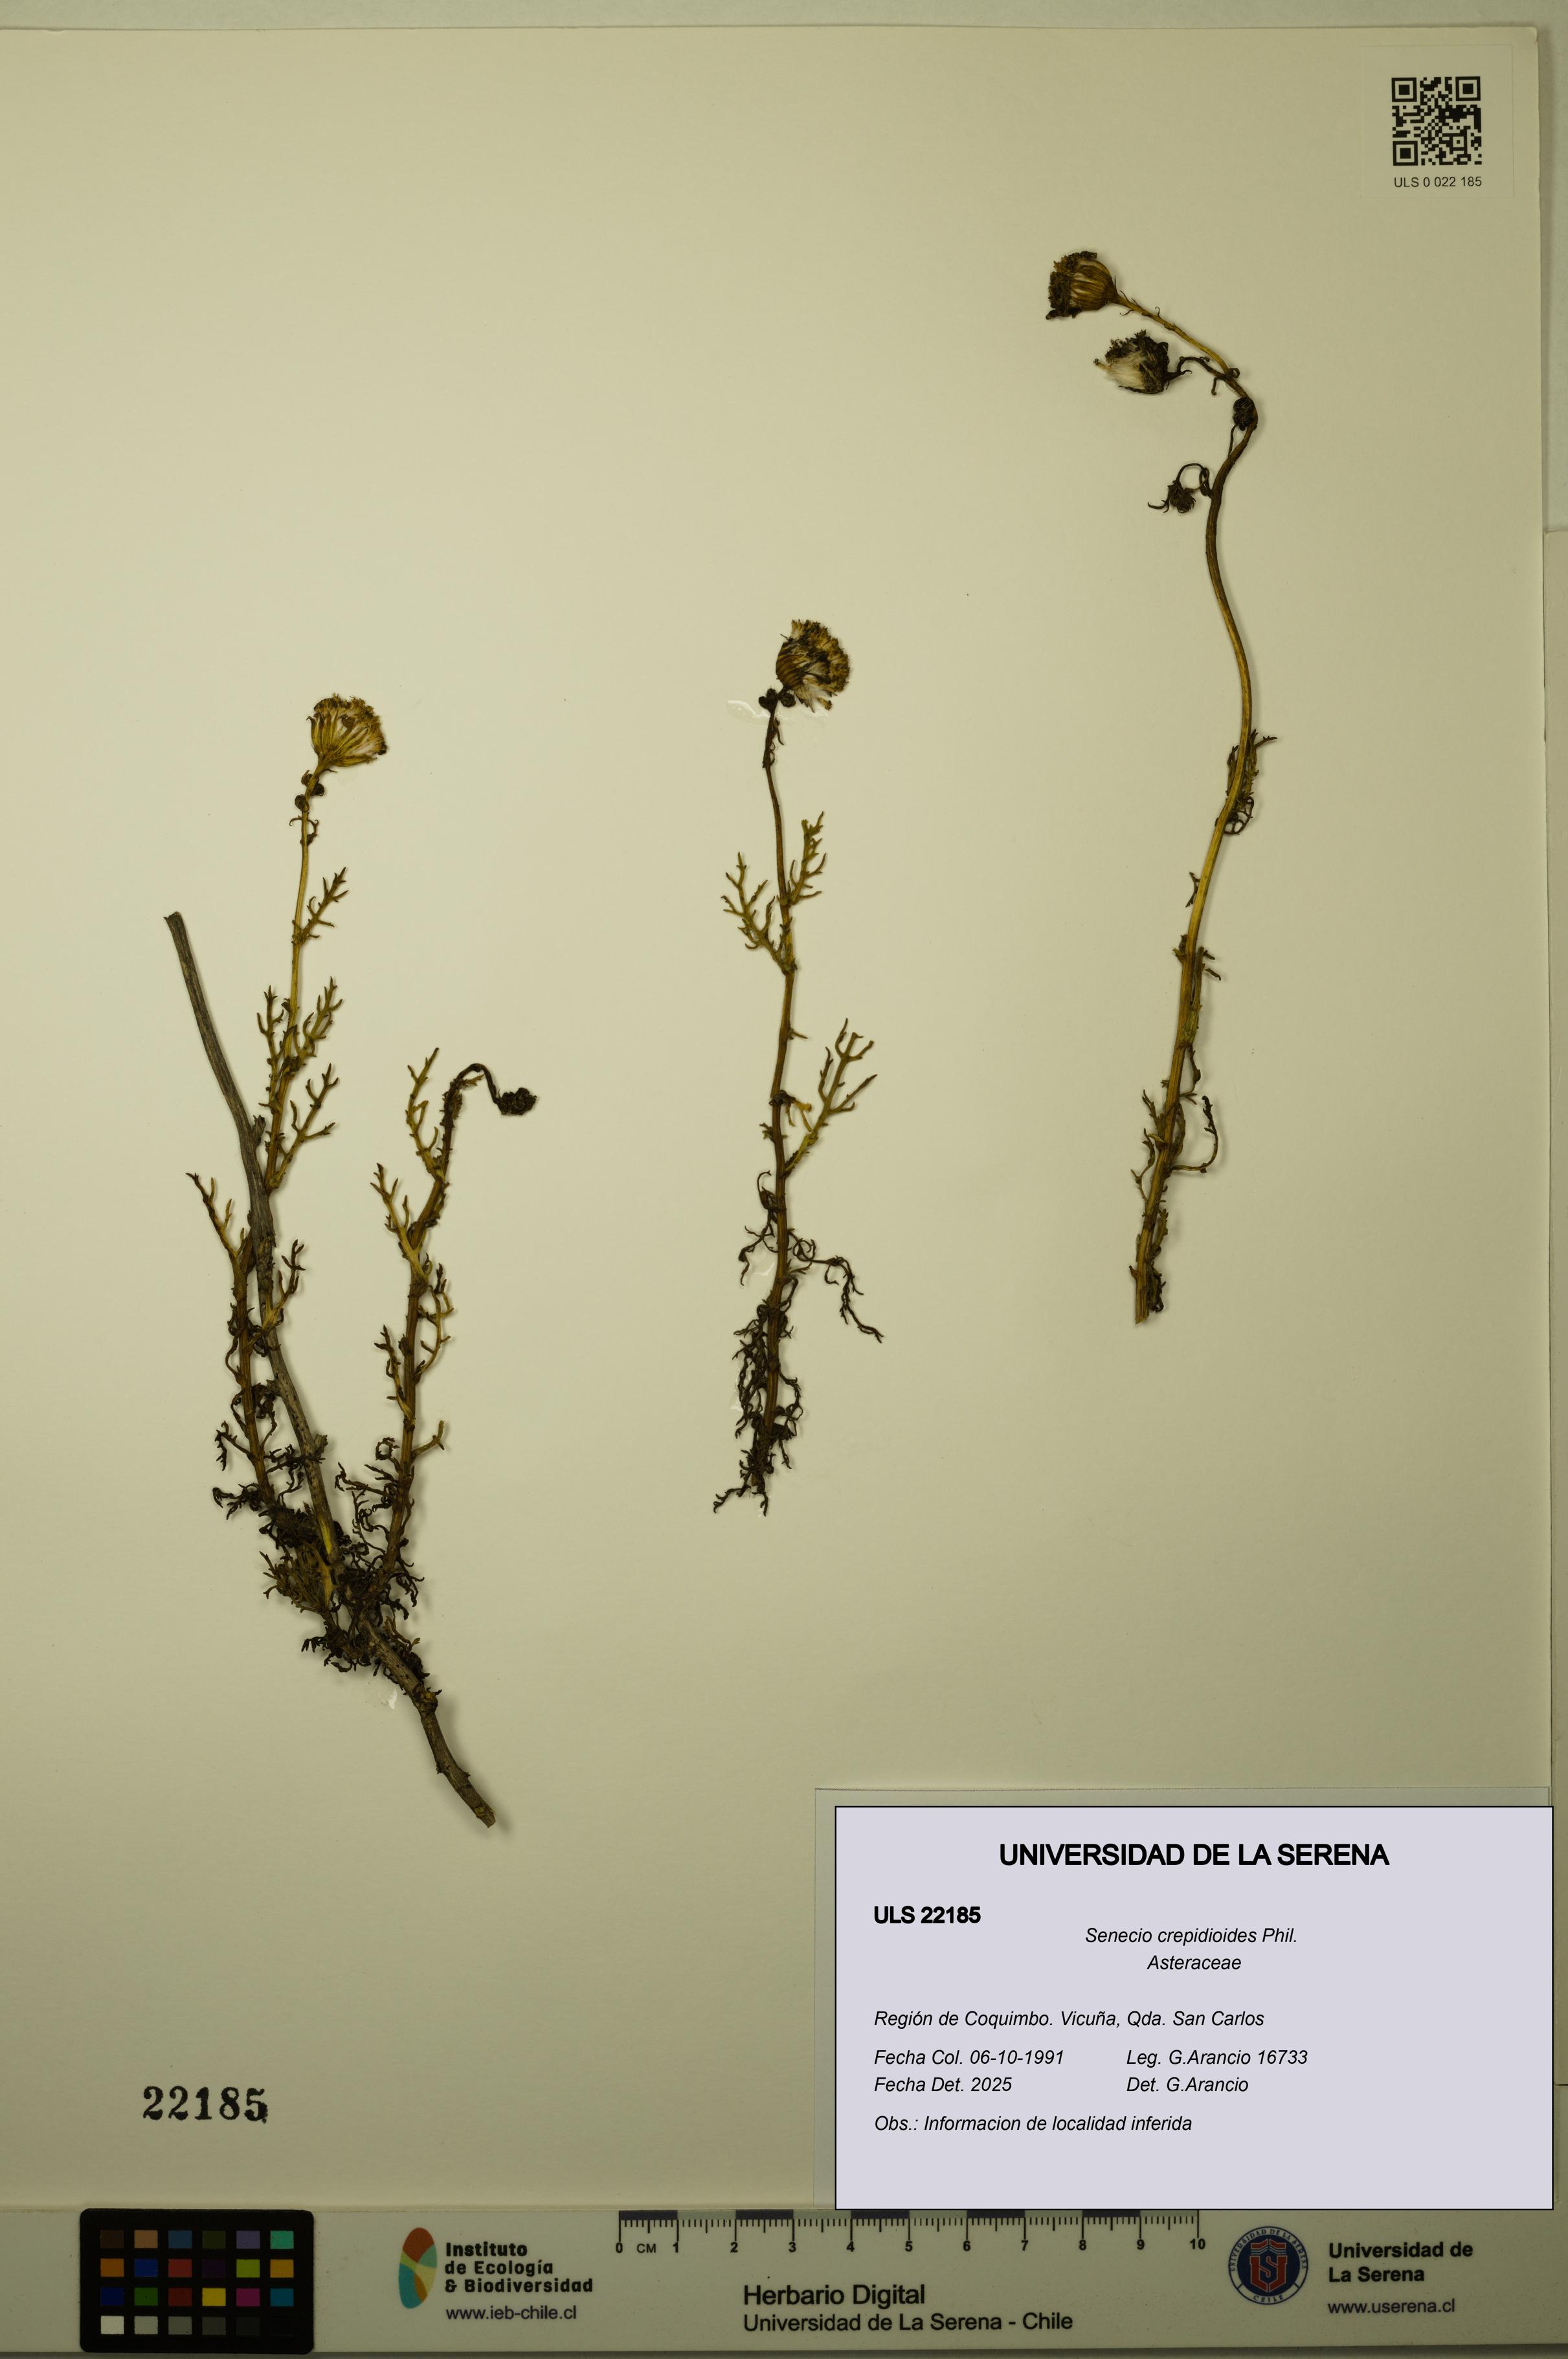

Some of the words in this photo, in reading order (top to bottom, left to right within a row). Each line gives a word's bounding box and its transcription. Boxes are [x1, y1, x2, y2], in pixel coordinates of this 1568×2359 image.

[1394, 177, 1418, 187] ULS
[1424, 177, 1429, 187] 0
[1435, 177, 1455, 186] 022
[1461, 177, 1481, 186] 185
[143, 2086, 267, 2123] 22185
[446, 2241, 527, 2256] Instituto
[616, 2241, 623, 2253] 0
[637, 2244, 656, 2253] CM
[673, 2241, 678, 2253] 1
[730, 2242, 738, 2253] 2
[789, 2242, 796, 2252] 3
[847, 2241, 855, 2252] 4
[905, 2241, 912, 2252] 5
[963, 2241, 970, 2251] 6
[1022, 2241, 1028, 2251] 7
[1079, 2239, 1086, 2250] 8
[1137, 2239, 1145, 2250] 9
[1190, 2239, 1205, 2250] 10
[1330, 2242, 1443, 2259] Universidad
[1450, 2241, 1473, 2257] de
[445, 2261, 466, 2275] de
[475, 2260, 552, 2277] Ecología
[1329, 2267, 1351, 2282] La
[1358, 2266, 1424, 2282] Serena
[445, 2279, 457, 2292] &
[465, 2278, 592, 2292] Biodiversidad
[745, 2285, 844, 2305] Herbario
[853, 2284, 924, 2309] Digital
[446, 2305, 576, 2320] www.ieb-chile.cl
[1328, 2299, 1455, 2313] www.userena.cl
[745, 2314, 860, 2331] Universidad
[868, 2314, 892, 2331] de
[900, 2314, 923, 2331] La
[930, 2313, 1002, 2331] Serena
[1023, 2312, 1073, 2329] Chile
